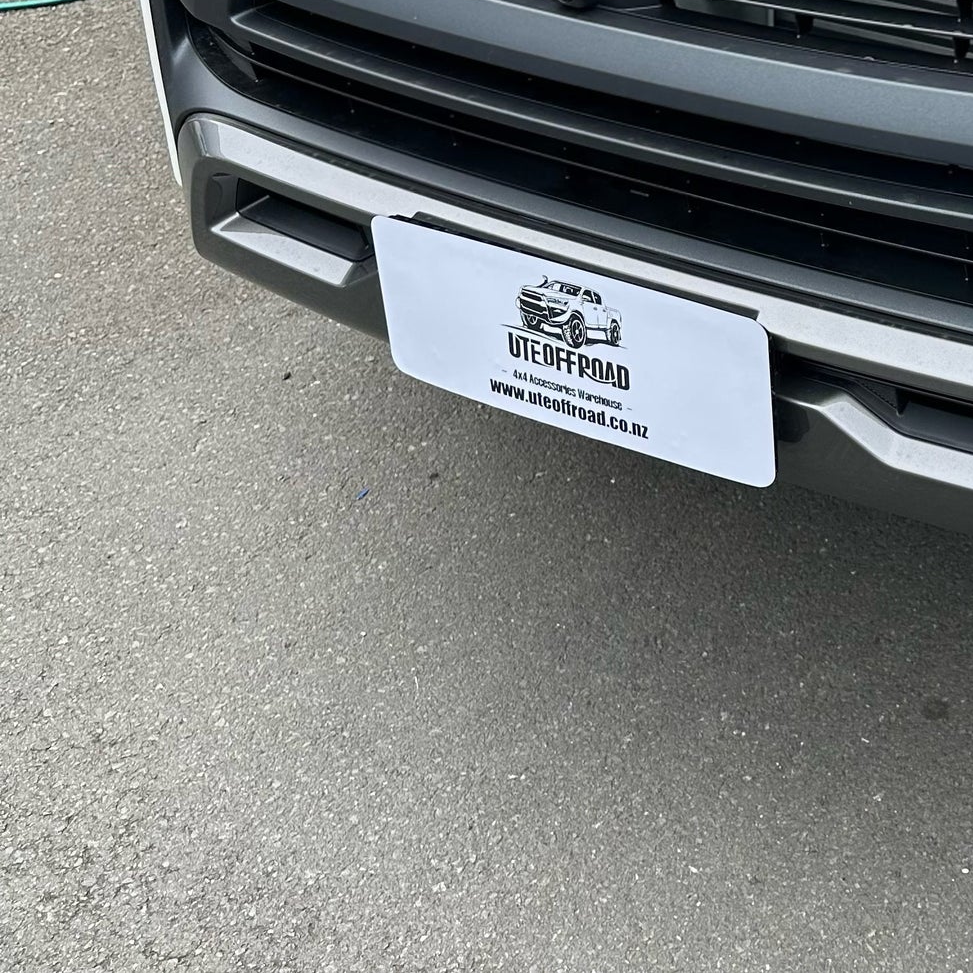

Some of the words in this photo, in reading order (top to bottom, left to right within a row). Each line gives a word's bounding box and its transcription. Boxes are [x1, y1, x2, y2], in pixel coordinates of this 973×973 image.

[490, 378, 649, 439] www.uteoffroad.co.nz
[512, 369, 528, 382] 4x4
[529, 373, 577, 397] Accessories
[577, 388, 623, 411] Warehouse
